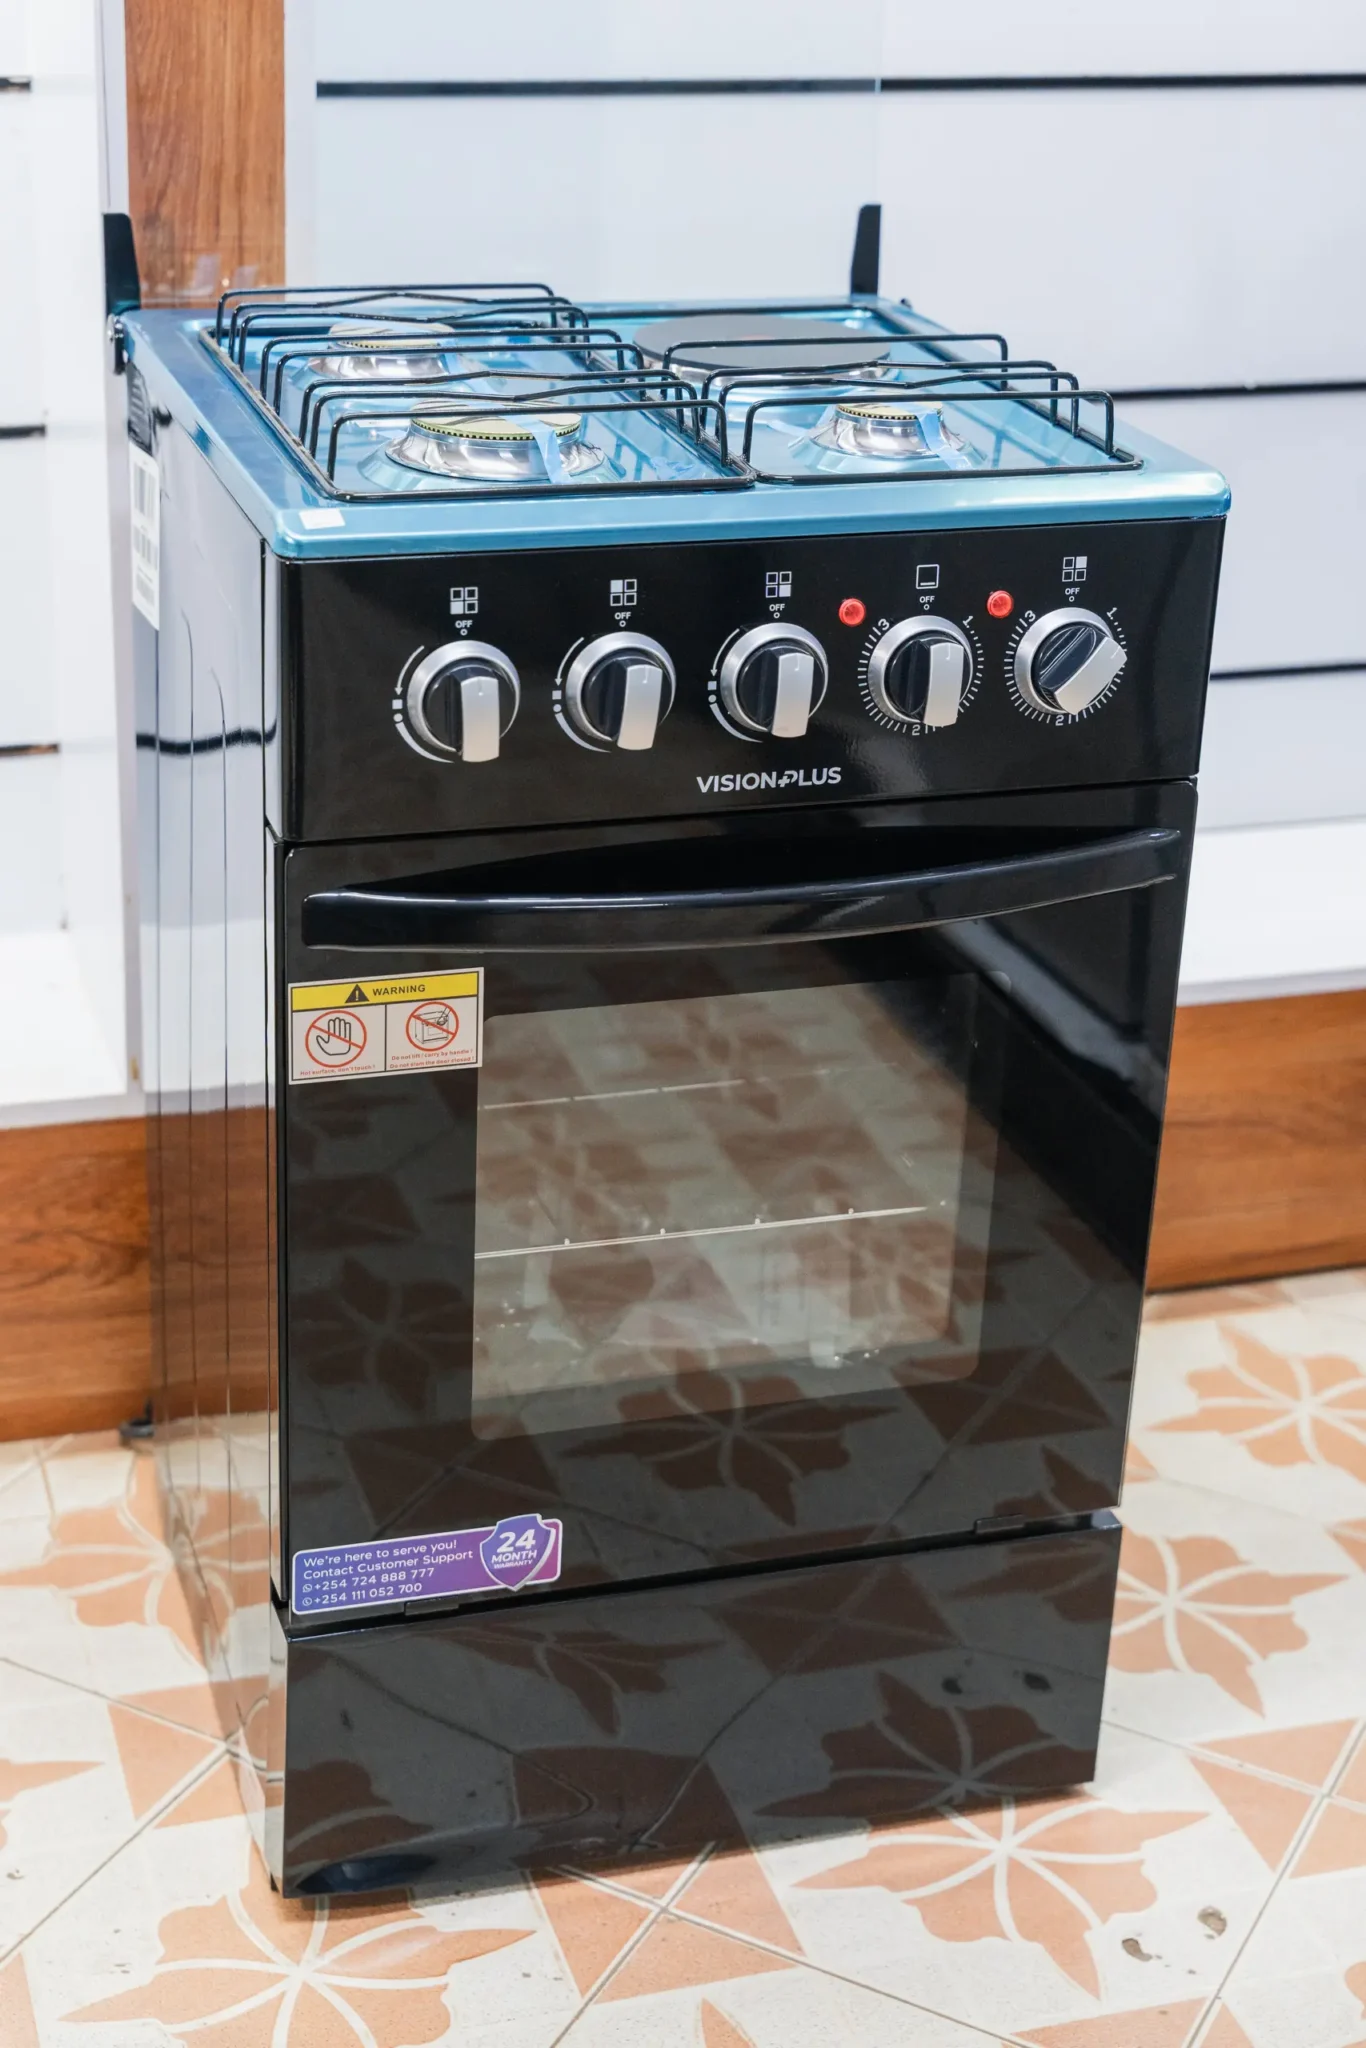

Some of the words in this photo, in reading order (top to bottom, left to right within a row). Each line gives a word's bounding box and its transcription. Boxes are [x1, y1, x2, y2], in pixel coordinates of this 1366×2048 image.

[614, 612, 632, 620] OFF
[1024, 610, 1036, 622] 3
[455, 620, 473, 628] OFF
[878, 618, 890, 631] 3
[1055, 714, 1064, 726] 2
[912, 725, 920, 736] 2
[372, 984, 426, 996] WARNING
[497, 1528, 536, 1553] 24
[303, 1555, 341, 1567] We're
[344, 1552, 373, 1563] here
[376, 1549, 390, 1558] to
[393, 1544, 427, 1556] serve
[430, 1539, 457, 1554] you!
[491, 1549, 537, 1563] MONTH
[303, 1565, 354, 1580] Contact
[357, 1557, 419, 1573] Customer
[422, 1550, 474, 1565] Support
[493, 1559, 533, 1569] WARRANTY
[314, 1578, 347, 1591] +254
[351, 1574, 377, 1587] 724
[381, 1570, 407, 1583] 888
[410, 1567, 435, 1579] 777
[314, 1592, 347, 1604] +254
[351, 1590, 366, 1600] 111
[369, 1586, 394, 1598] 052
[398, 1582, 423, 1594] 700
